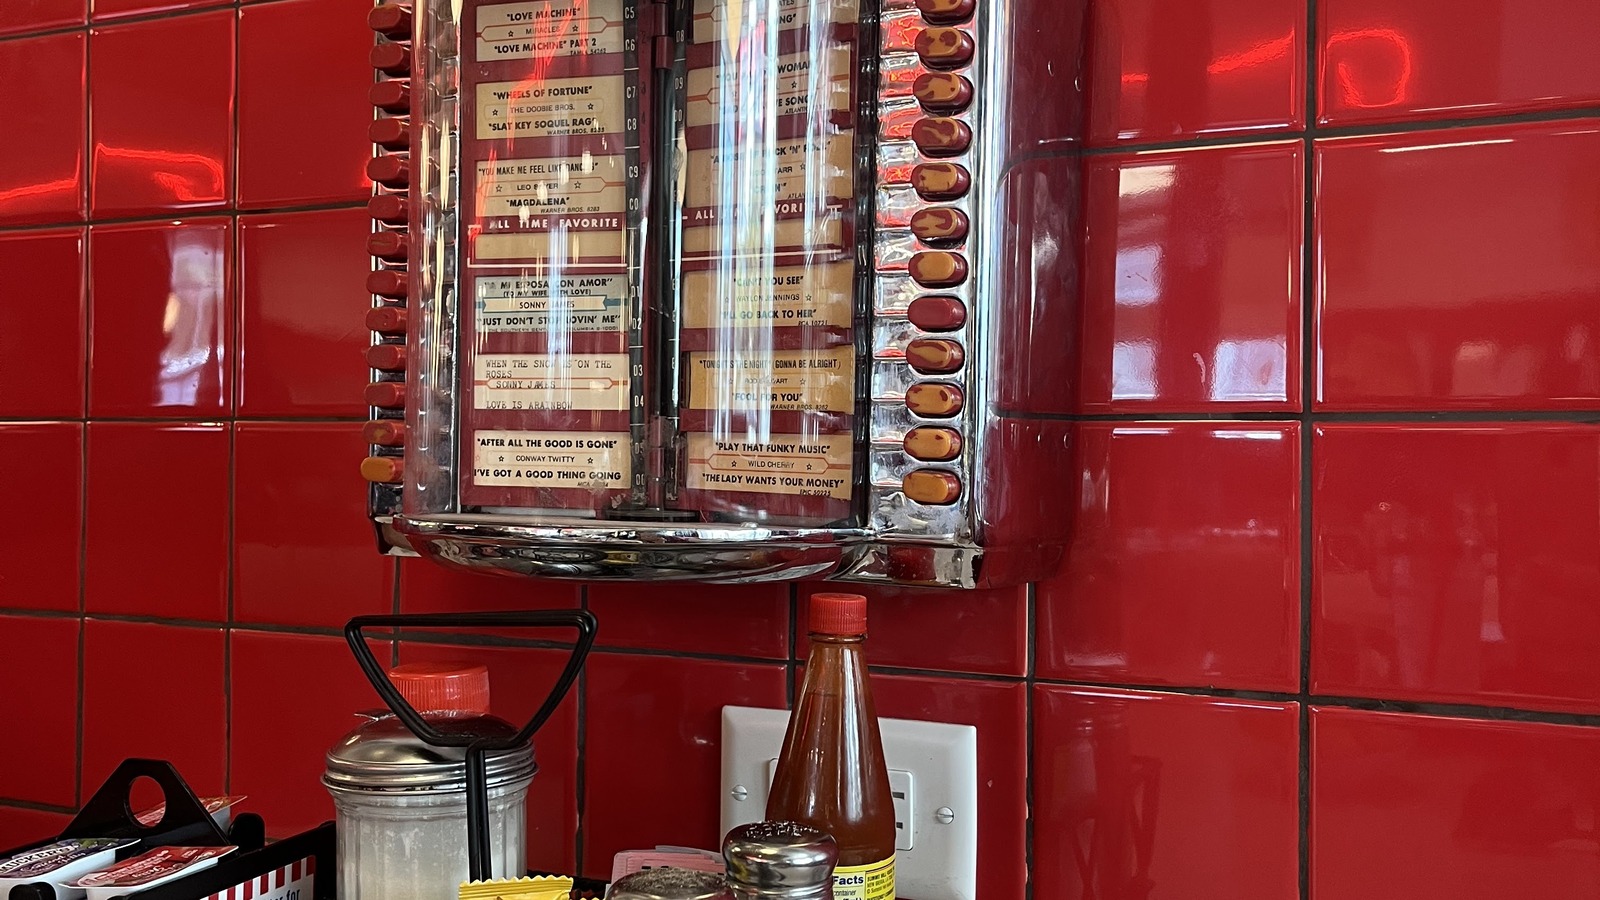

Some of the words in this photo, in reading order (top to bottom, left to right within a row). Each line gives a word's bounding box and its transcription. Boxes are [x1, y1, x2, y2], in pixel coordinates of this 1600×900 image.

[507, 12, 533, 21] "LOVE
[535, 8, 581, 19] MACHINE"
[625, 7, 634, 19] C5
[494, 45, 520, 54] "LOVE
[522, 40, 567, 52] MACHINE"
[570, 39, 589, 48] PART
[592, 38, 597, 46] 2
[625, 38, 635, 50] C6
[493, 90, 531, 100] "WHEELS
[534, 88, 546, 98] OF
[548, 86, 593, 96] FORTUNE"
[626, 86, 636, 98] C7
[510, 106, 524, 114] THE
[526, 104, 553, 114] DOOBIE
[554, 103, 576, 112] BROS.
[488, 122, 513, 131] "SLAT
[515, 122, 532, 130] KEY
[534, 118, 570, 129] SOQUEL
[627, 118, 637, 130] C8
[478, 168, 495, 176] "YOU
[496, 165, 514, 176] MAKE
[530, 164, 546, 174] FEEL
[628, 166, 638, 178] C9
[506, 196, 570, 207] "MAGDALENA"
[695, 209, 714, 220] ALL
[520, 218, 548, 229] TIME
[559, 218, 618, 228] FAVORITE
[579, 278, 613, 288] AMOR"
[786, 276, 804, 286] SEE"
[520, 301, 546, 309] SONNY
[506, 316, 534, 326] DON'T
[566, 314, 598, 324] LOVIN'
[602, 313, 621, 323] ME"
[741, 310, 754, 320] GO
[756, 310, 779, 319] BACK
[782, 310, 794, 318] TO
[796, 308, 817, 318] HER"
[486, 360, 507, 368] WHEN
[512, 360, 528, 368] THE
[595, 360, 612, 368] THE
[798, 360, 807, 368] BE
[808, 358, 841, 370] ALRIGHT)
[486, 370, 512, 378] ROSES
[496, 380, 523, 389] SONNY
[528, 380, 556, 390] JAMES
[780, 392, 803, 402] YOU"
[486, 400, 507, 408] LOVE
[512, 400, 522, 408] IS
[477, 438, 505, 446] "AFTER
[508, 438, 523, 447] ALL
[526, 439, 542, 448] THE
[544, 440, 572, 448] GOOD
[576, 440, 584, 448] IS
[586, 440, 618, 449] GONE"
[716, 442, 739, 452] "PLAY
[742, 443, 763, 452] THAT
[766, 444, 796, 454] FUNKY
[798, 445, 830, 454] MUSIC"
[767, 461, 795, 469] CHERRY
[474, 468, 490, 477] I'VE
[494, 470, 512, 478] GOT
[516, 470, 522, 478] A
[526, 470, 554, 478] GOOD
[557, 471, 586, 480] THING
[589, 472, 622, 480] GOING
[702, 473, 720, 483] "THE
[721, 474, 743, 484] LADY
[746, 476, 777, 486] WANTS
[779, 477, 804, 487] YOUR
[806, 478, 844, 488] MONEY"
[833, 876, 864, 885] Facts
